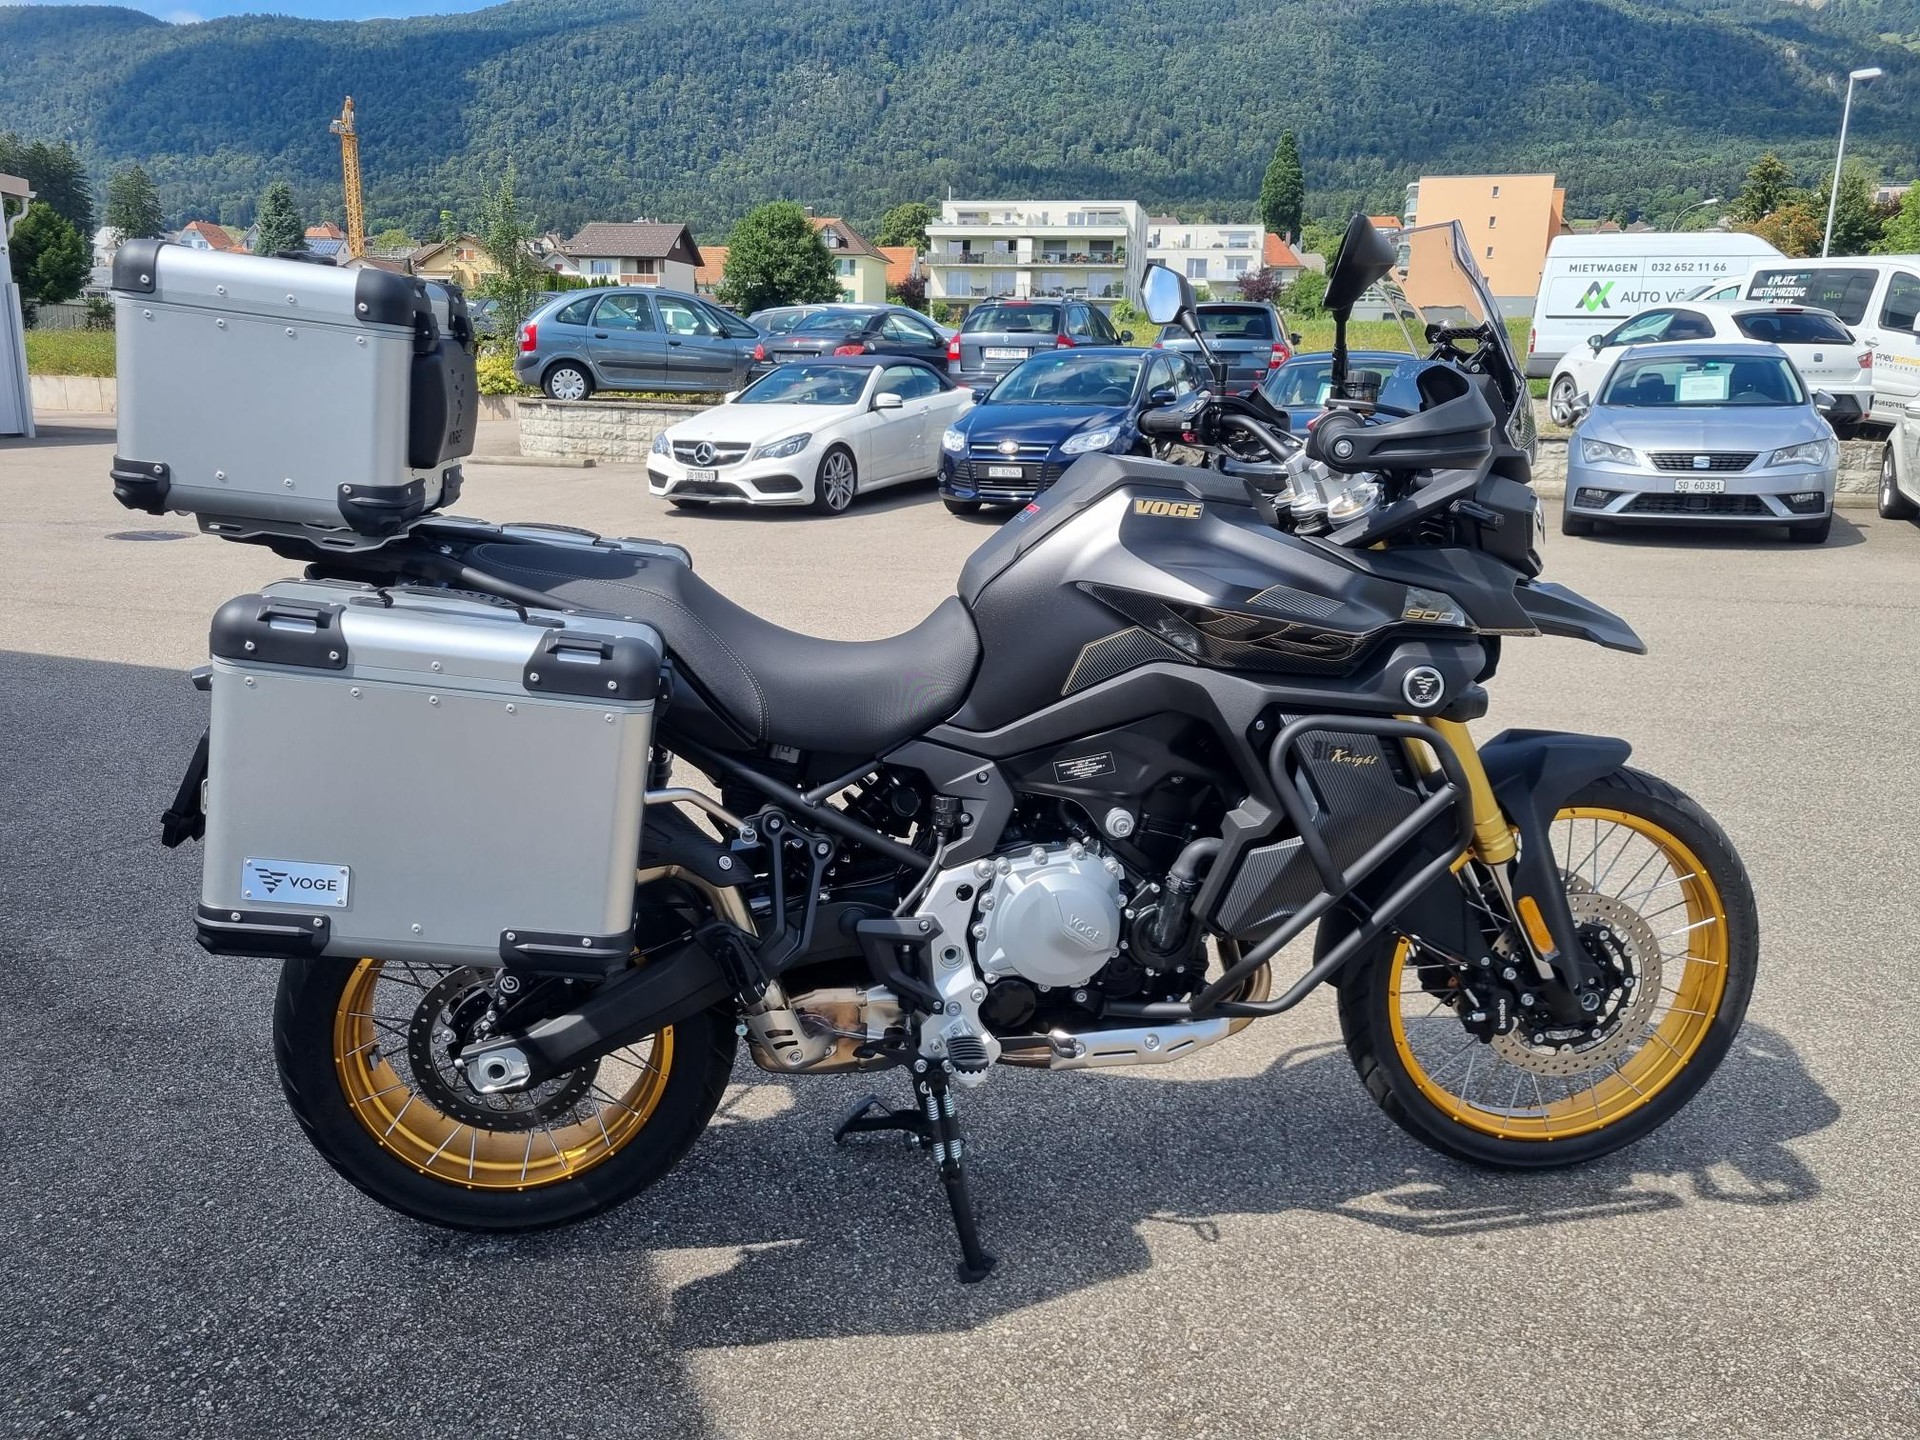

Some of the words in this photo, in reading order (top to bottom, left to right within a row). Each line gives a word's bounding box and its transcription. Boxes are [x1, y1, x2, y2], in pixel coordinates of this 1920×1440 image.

[1569, 263, 1638, 273] MIETWAGEN
[1651, 263, 1671, 272] 032
[1674, 263, 1694, 272] 652
[1698, 263, 1710, 272] 11
[1713, 263, 1727, 272] 66
[1773, 275, 1798, 286] PLATZ
[1620, 291, 1661, 303] AUTO
[1694, 481, 1721, 490] 60381
[1135, 500, 1202, 518] VOGE
[1405, 609, 1456, 622] 900
[1330, 749, 1379, 767] Knight
[289, 876, 338, 892] VOGE
[1497, 998, 1506, 1029] brembo
